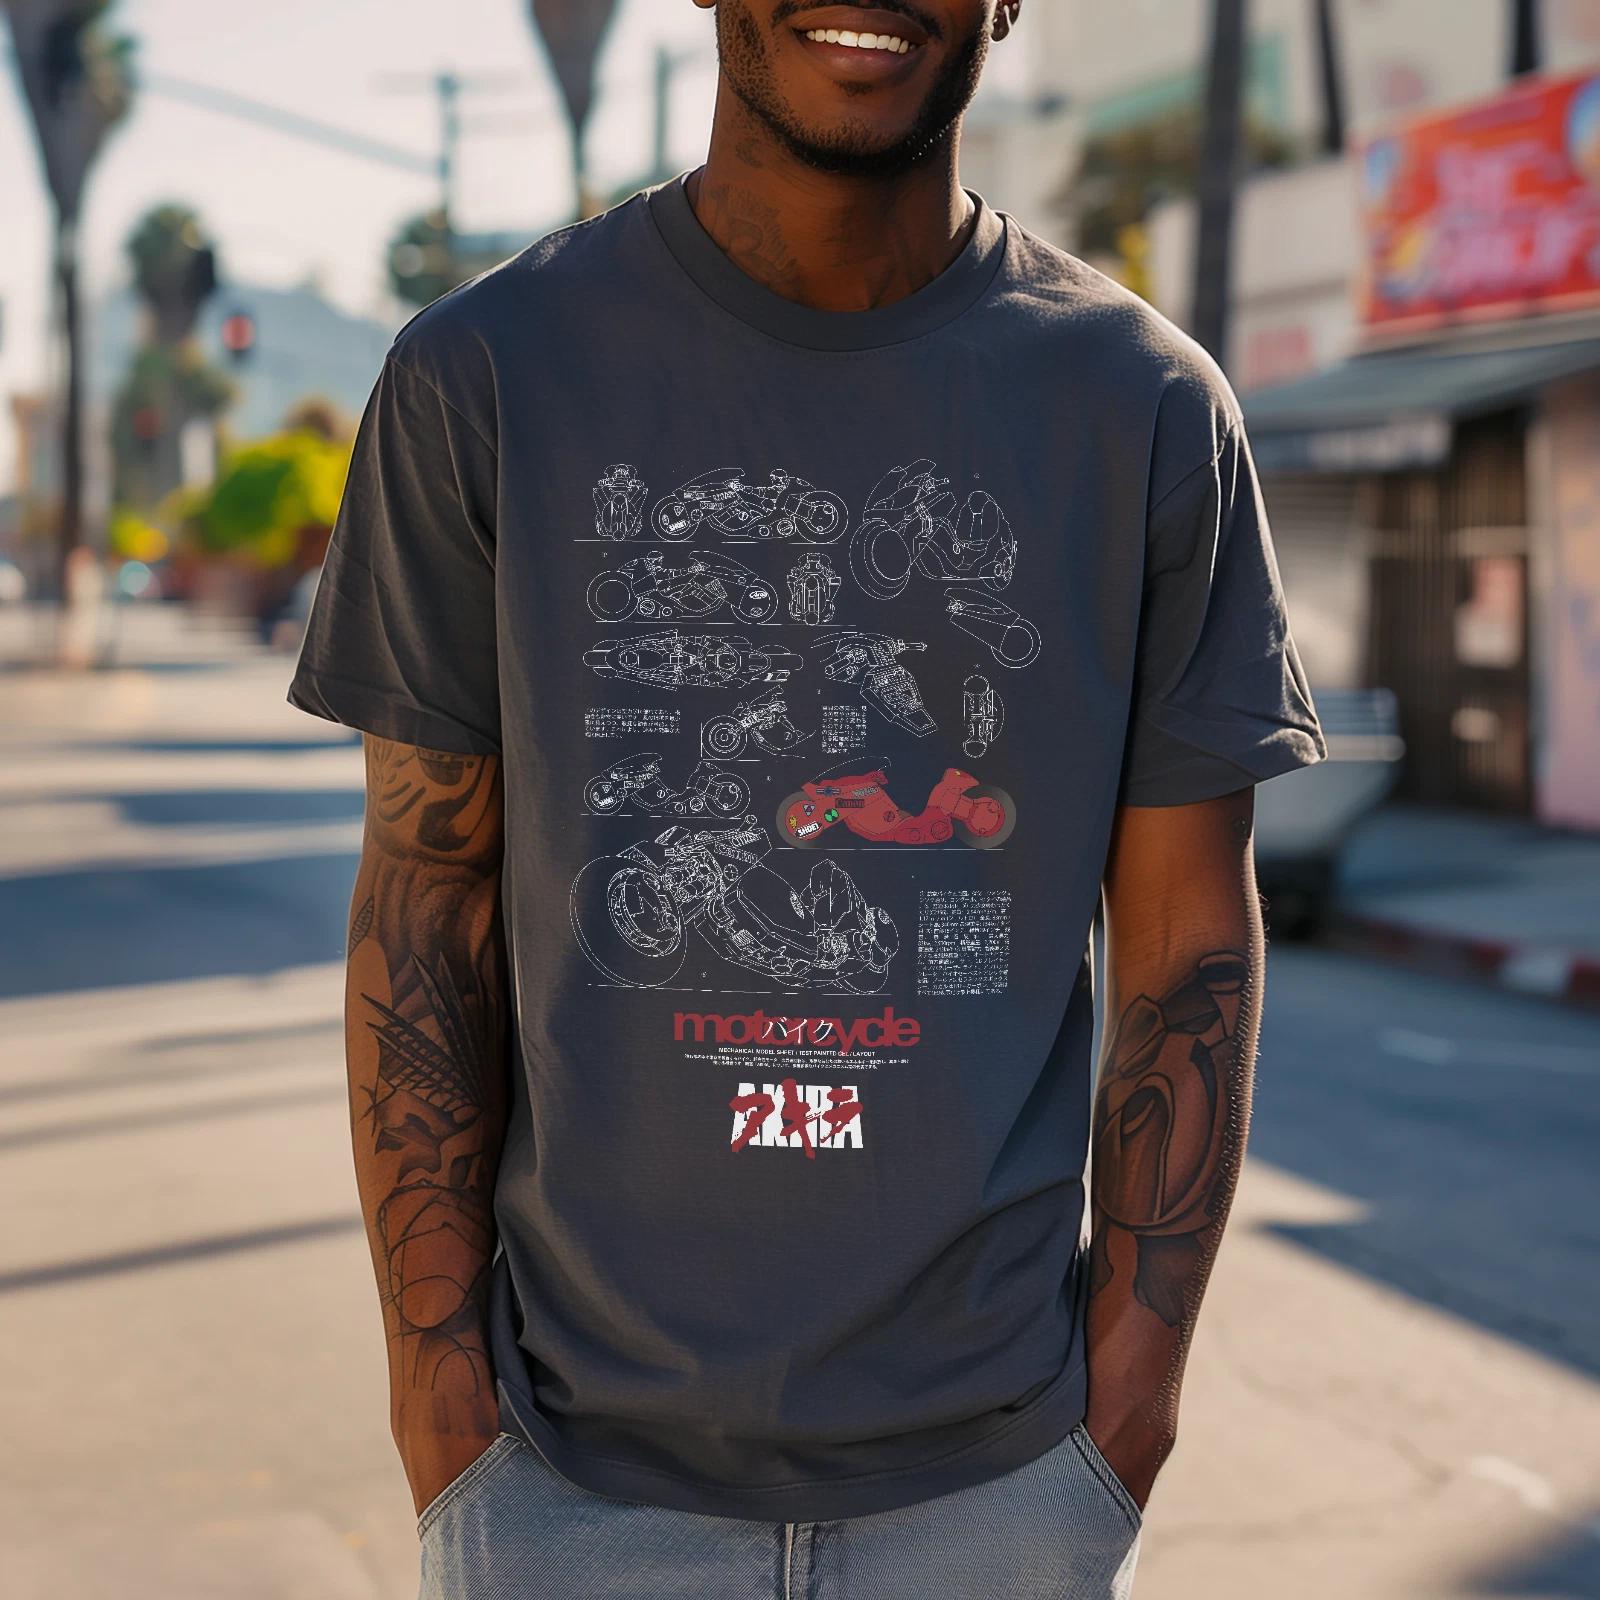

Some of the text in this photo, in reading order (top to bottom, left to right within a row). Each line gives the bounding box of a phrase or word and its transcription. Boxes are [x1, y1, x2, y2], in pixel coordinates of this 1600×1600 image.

[673, 1007, 921, 1053] motorcycle
[718, 1047, 754, 1055] MECHANICAL
[761, 1016, 835, 1044] バイク
[729, 1078, 864, 1160] アキラ
[730, 1082, 864, 1149] AKIRA
